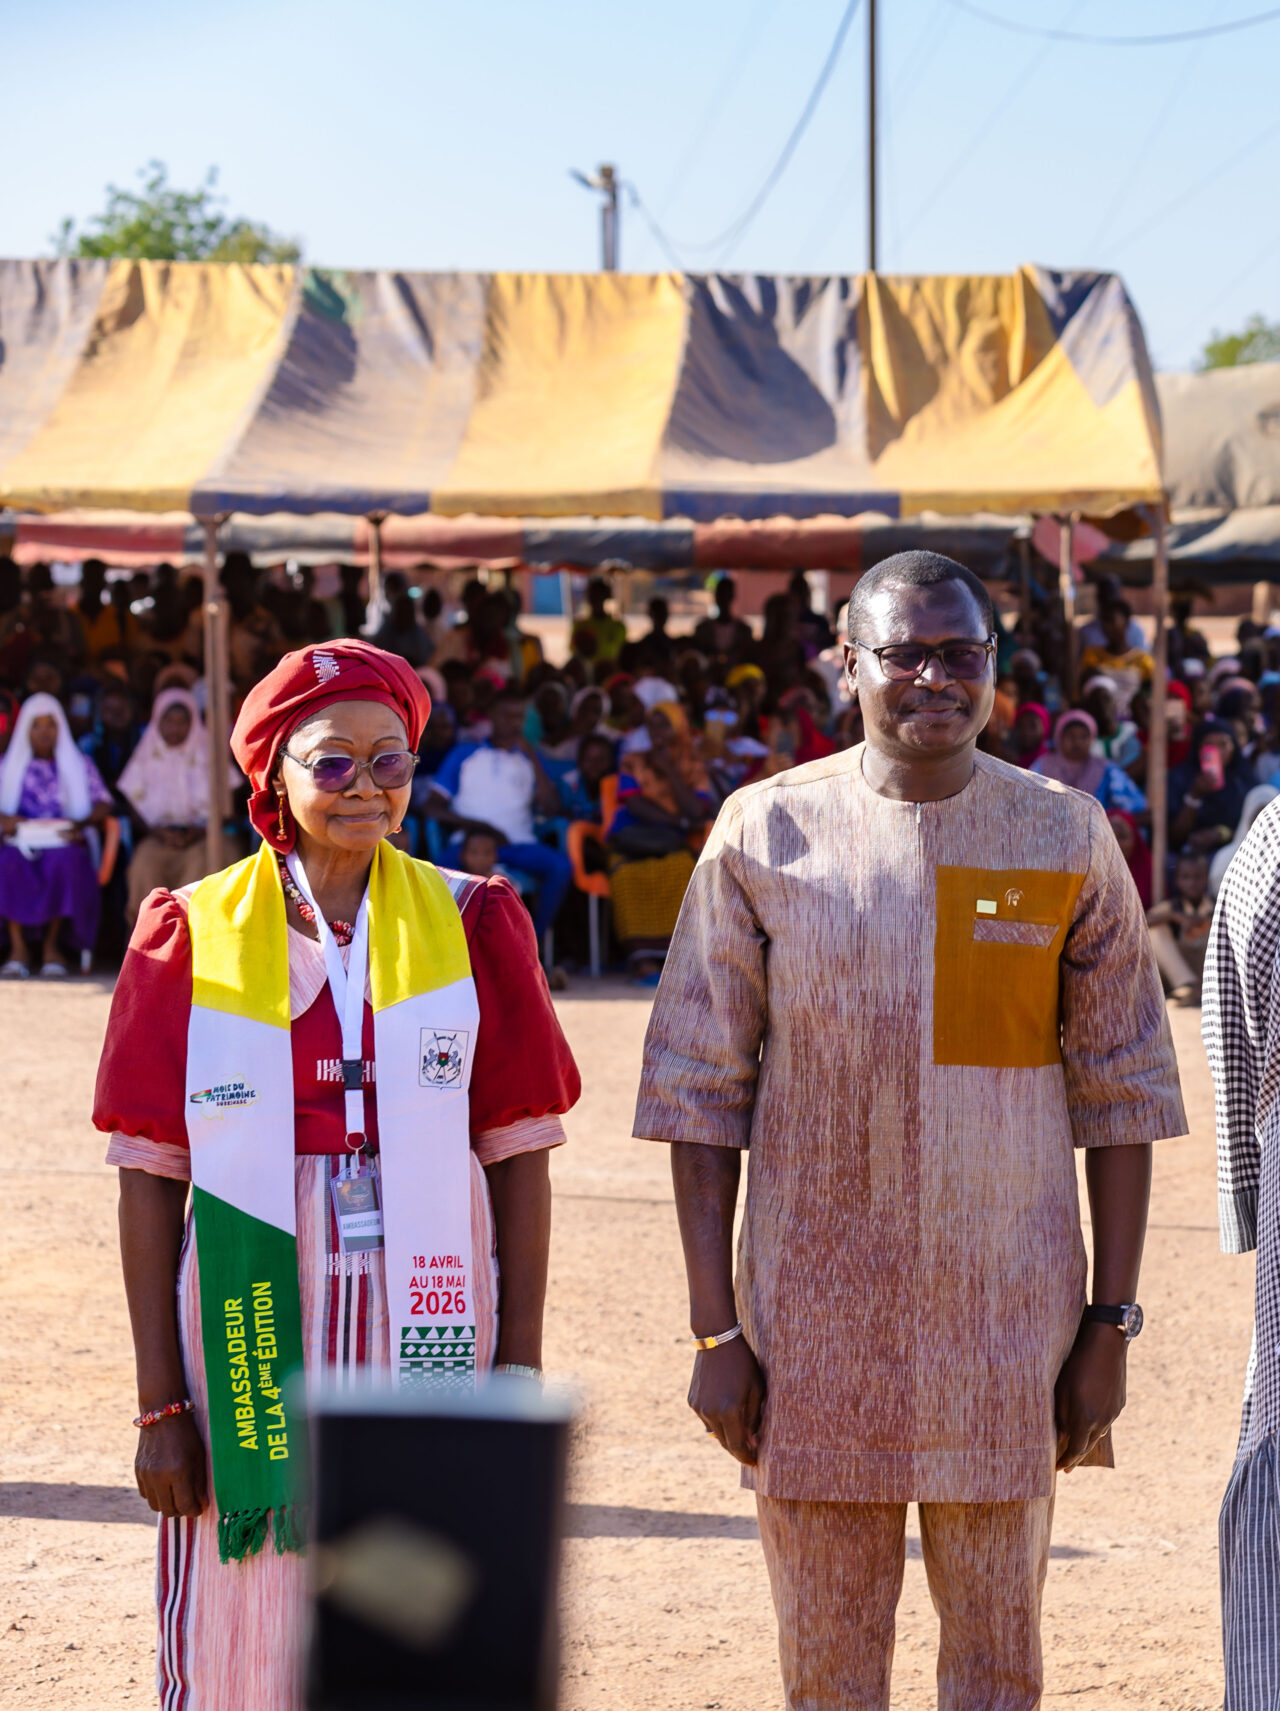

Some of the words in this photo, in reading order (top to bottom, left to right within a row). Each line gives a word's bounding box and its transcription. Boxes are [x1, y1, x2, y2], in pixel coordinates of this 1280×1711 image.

[206, 1090, 256, 1102] PATRIMOINE
[232, 1083, 244, 1091] DU
[413, 1255, 426, 1269] 18
[429, 1255, 464, 1269] AVRIL
[409, 1276, 429, 1289] AU
[431, 1275, 444, 1289] 18
[446, 1275, 466, 1288] MAI
[410, 1290, 467, 1316] 2026
[252, 1281, 277, 1360] ÉDITION
[224, 1297, 259, 1450] AMBASSADEUR
[265, 1402, 286, 1430] LA
[267, 1433, 289, 1460] DE
